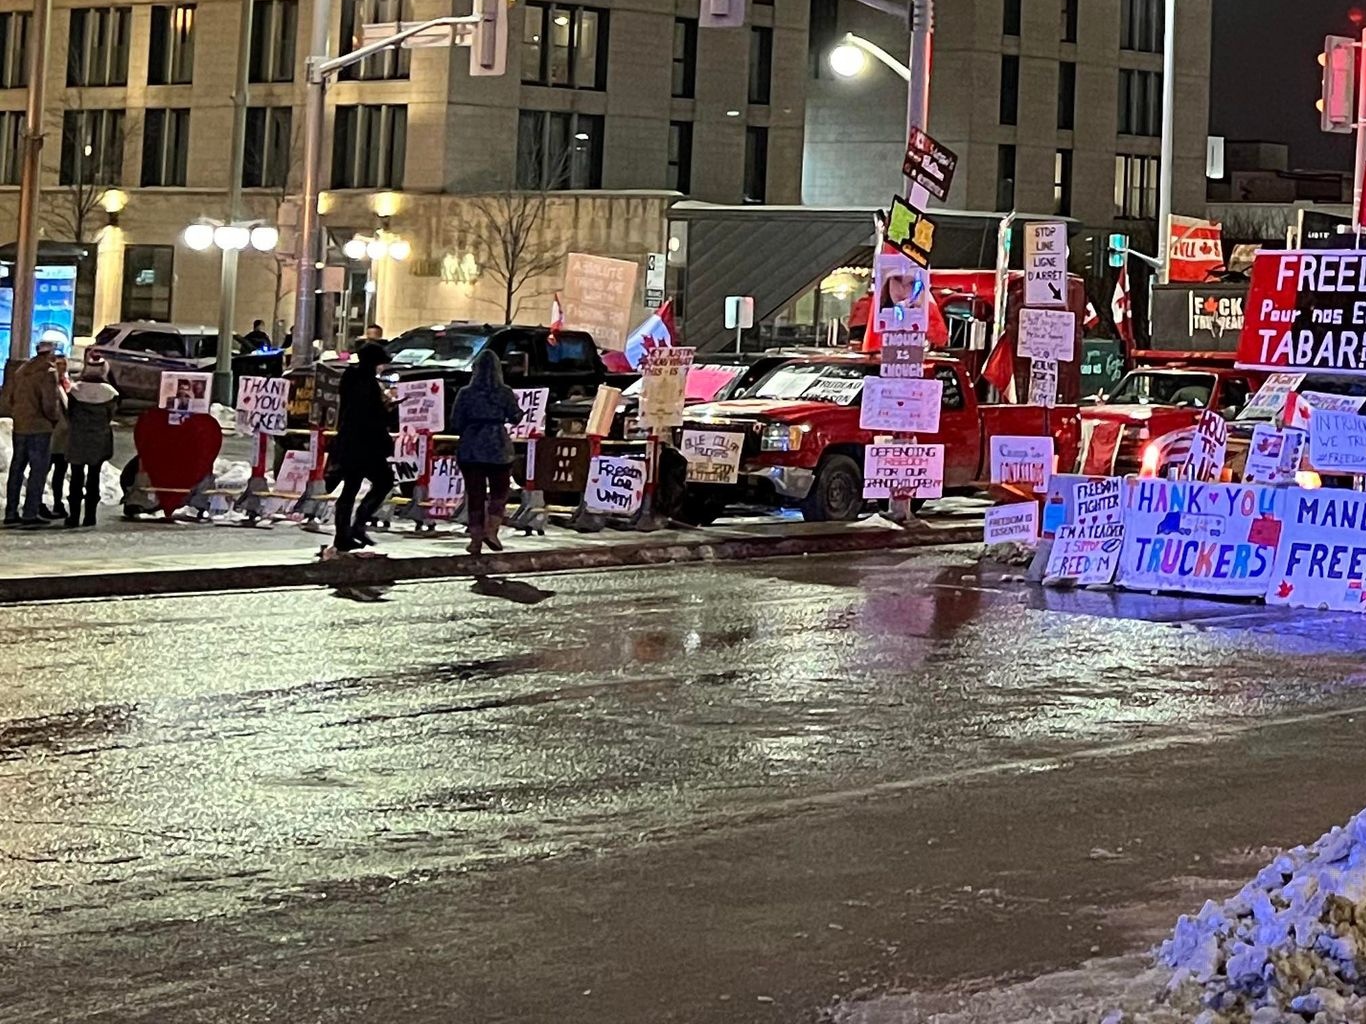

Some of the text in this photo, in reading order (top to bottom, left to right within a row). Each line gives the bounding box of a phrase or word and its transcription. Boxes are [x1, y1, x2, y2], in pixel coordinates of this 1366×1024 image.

[1035, 227, 1056, 238] STOP
[1036, 240, 1054, 251] LINE
[1033, 257, 1057, 268] LIGNE
[1194, 297, 1243, 315] FCK
[1312, 307, 1343, 325] nos
[254, 396, 280, 410] YOU
[1319, 436, 1337, 446] WE
[871, 447, 936, 457] DEFENDING
[876, 468, 927, 476] FOR OUR
[1077, 479, 1119, 500] FREEDOM
[1125, 475, 1277, 520] THANK YOU
[1078, 494, 1119, 516] FIGHTER
[1135, 537, 1268, 578] TRUCKERS
